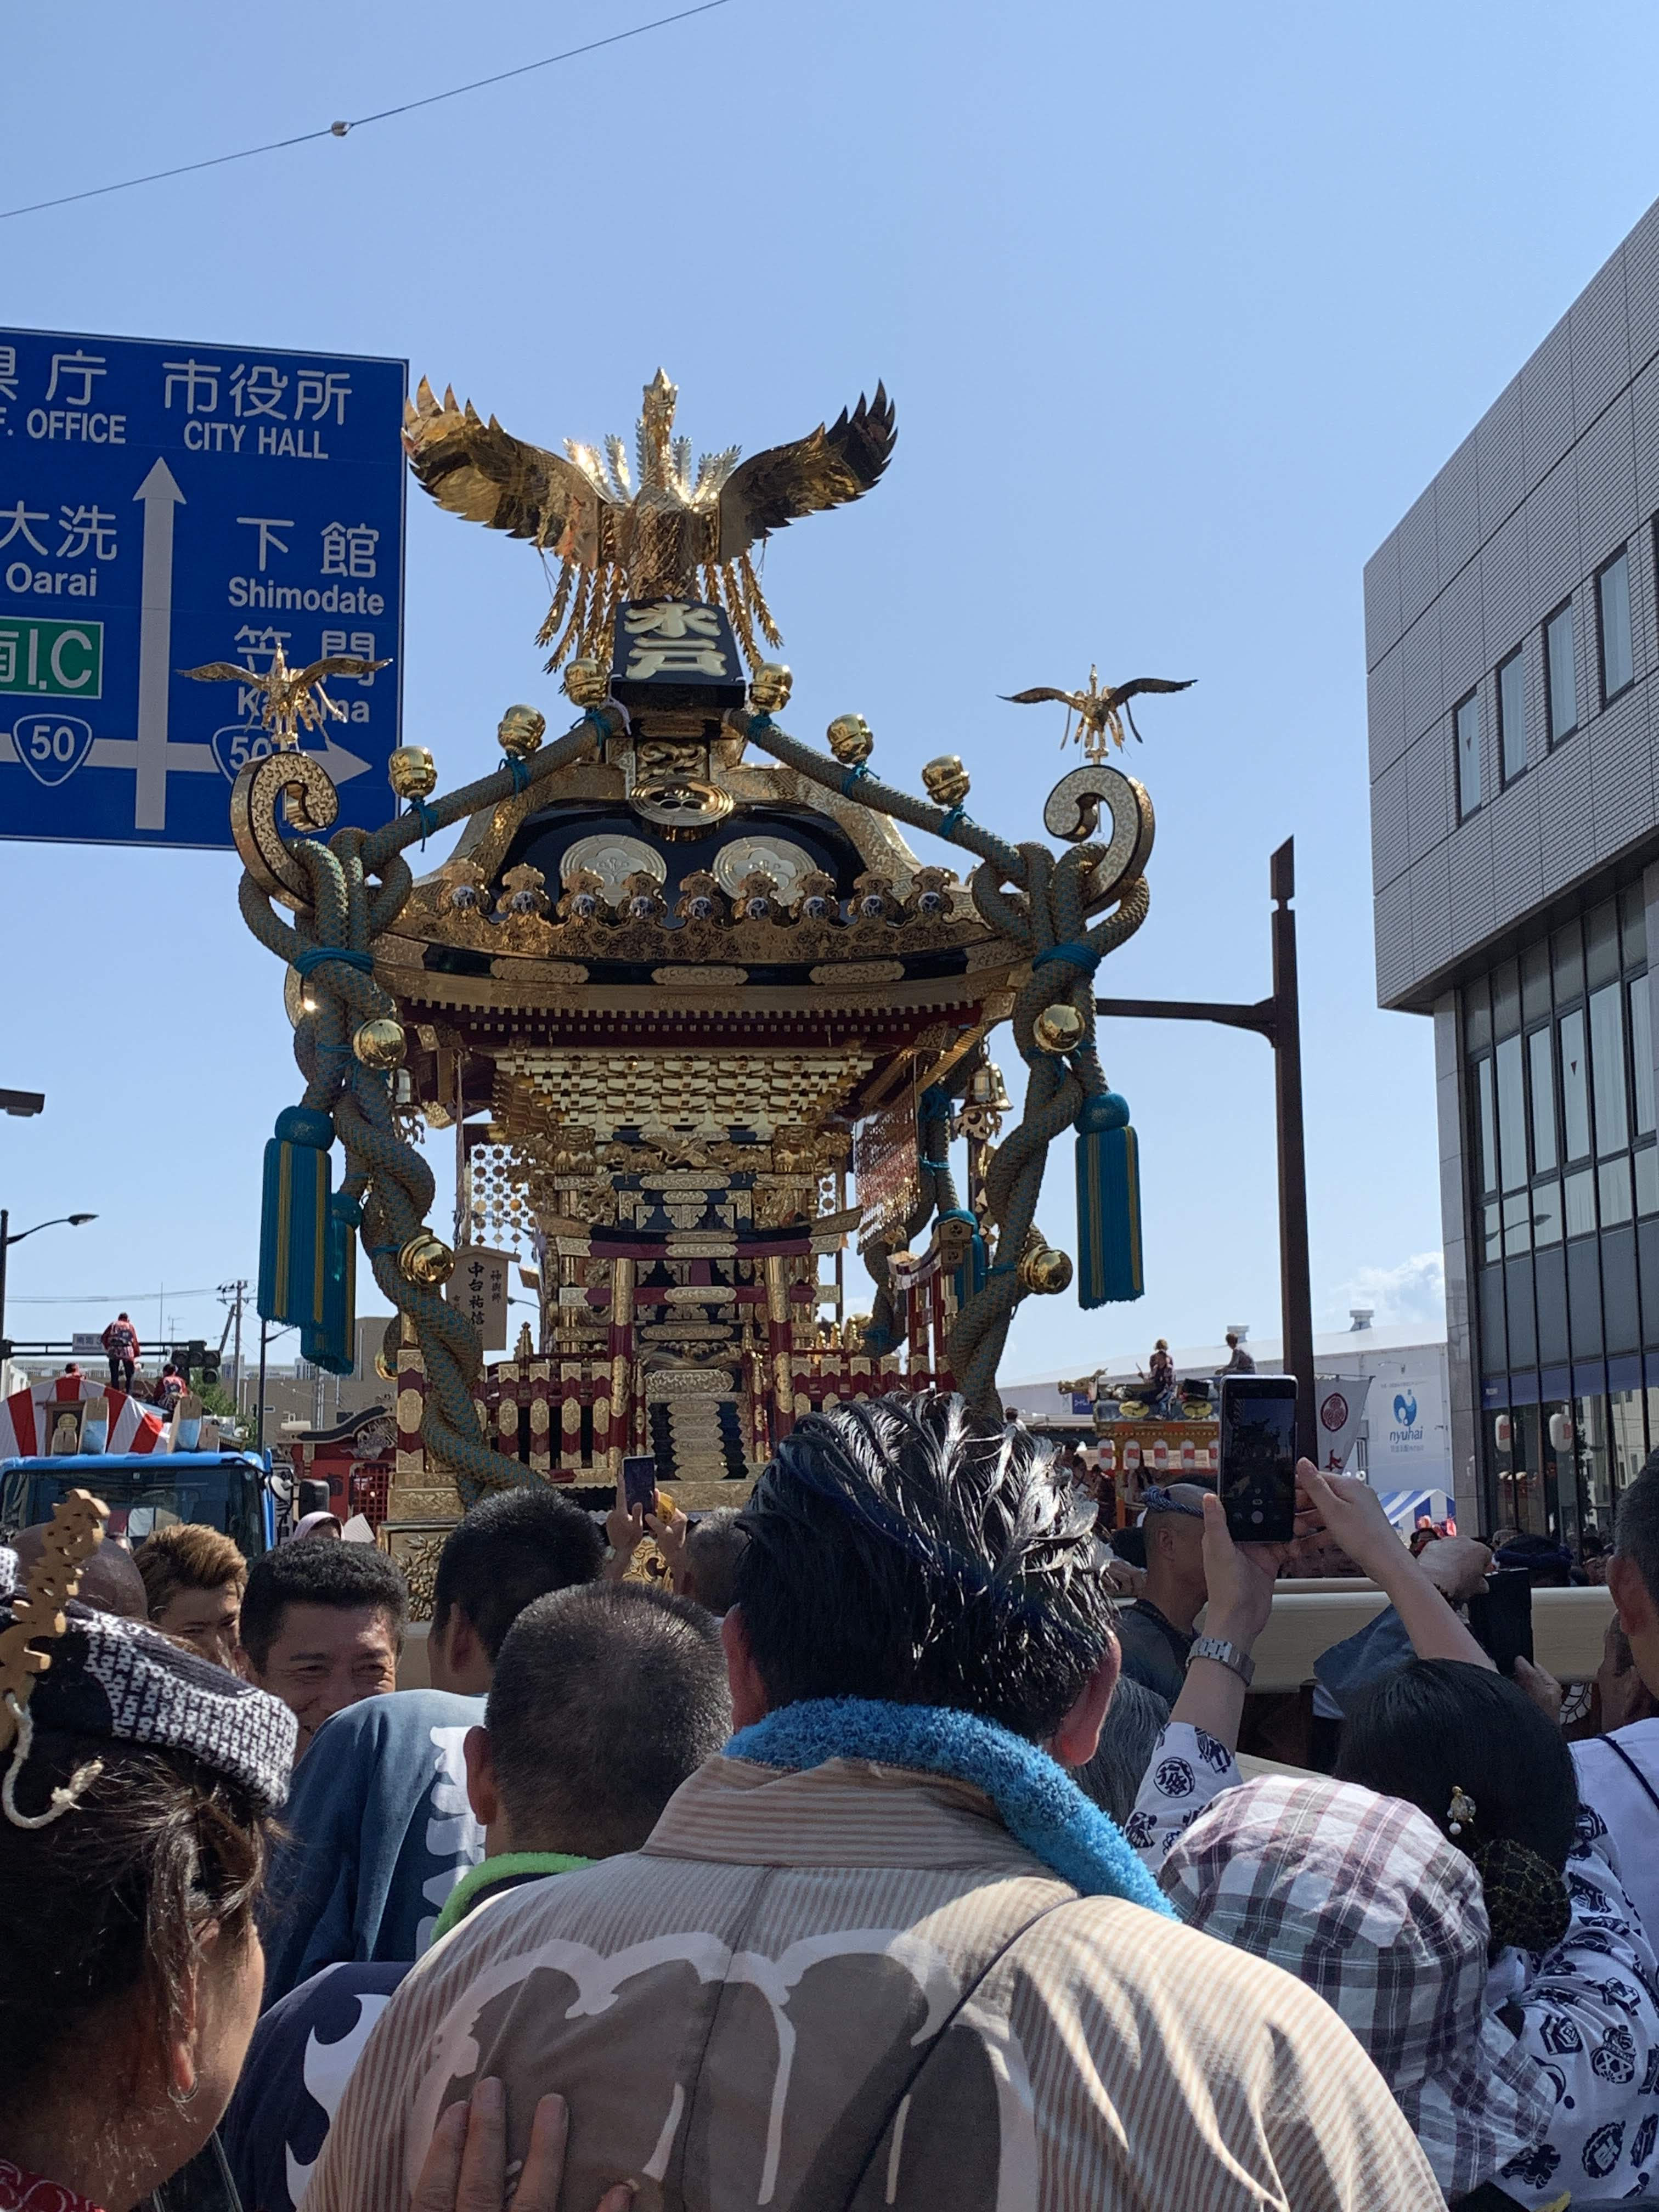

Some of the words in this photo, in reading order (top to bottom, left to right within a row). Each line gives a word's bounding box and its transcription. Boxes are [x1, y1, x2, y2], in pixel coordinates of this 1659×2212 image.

[162, 358, 352, 426] 市役所
[26, 408, 126, 444] OFFICE
[184, 420, 246, 453] CITY
[257, 426, 329, 460] HALL
[0, 500, 117, 560] 大洗
[236, 516, 379, 578] 下館
[5, 562, 97, 596] Oarai
[228, 576, 385, 616] Shimodate
[238, 686, 369, 723] Kma
[30, 725, 75, 761] 50
